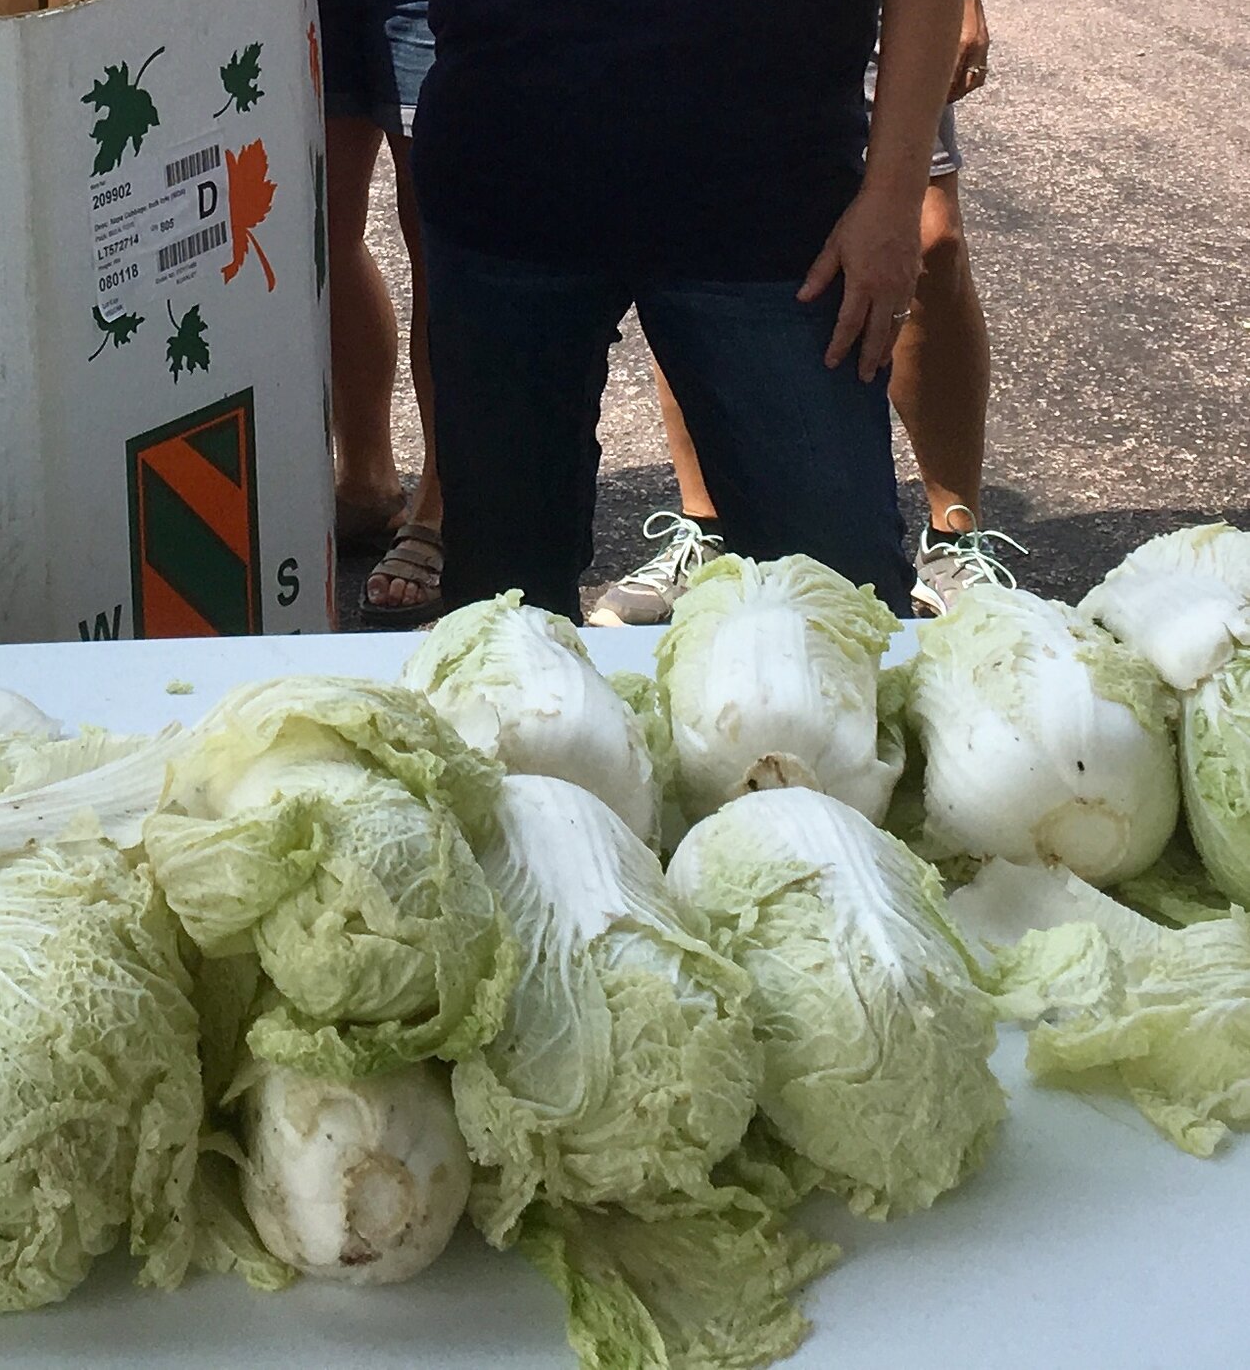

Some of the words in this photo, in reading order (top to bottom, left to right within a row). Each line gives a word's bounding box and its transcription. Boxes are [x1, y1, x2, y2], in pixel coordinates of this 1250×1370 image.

[92, 182, 132, 210] 209902
[197, 180, 218, 220] D
[97, 234, 139, 261] LT572714
[99, 263, 139, 292] 080118
